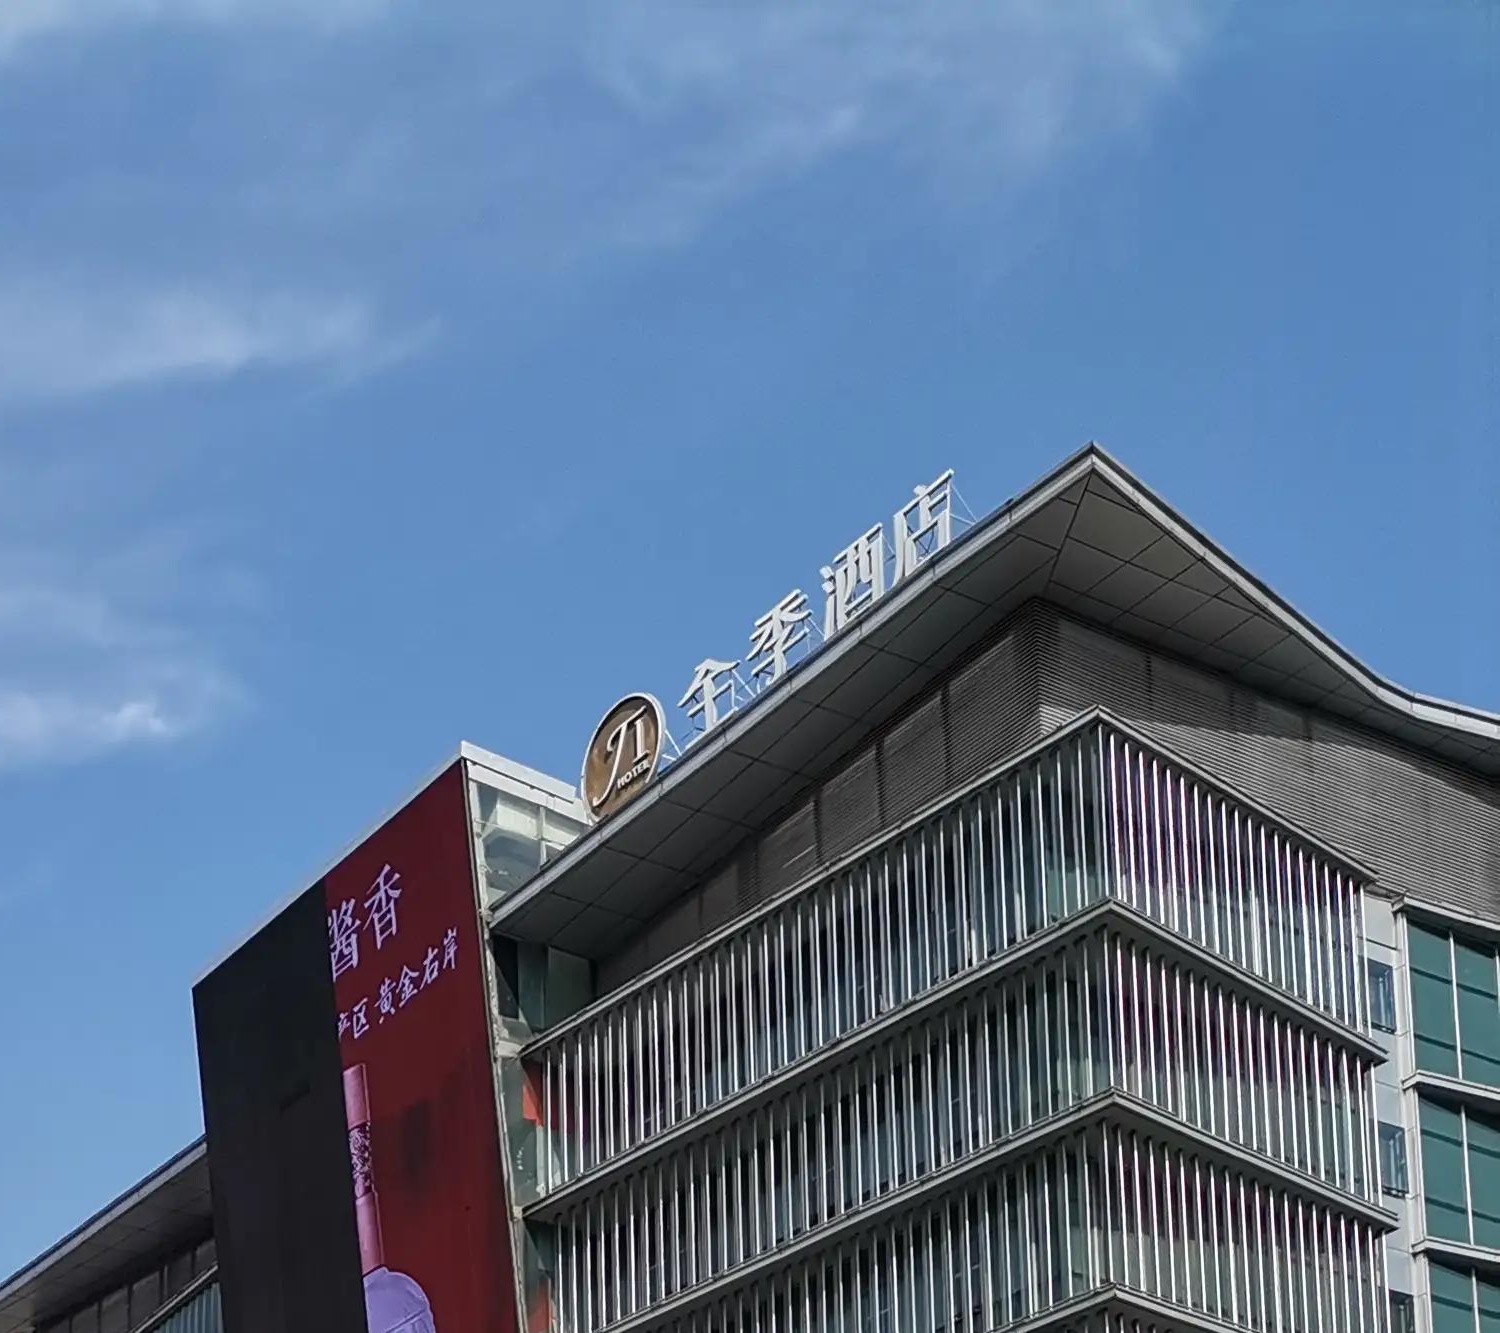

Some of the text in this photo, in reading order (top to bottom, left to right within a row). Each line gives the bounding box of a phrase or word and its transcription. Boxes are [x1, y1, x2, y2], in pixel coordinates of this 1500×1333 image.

[677, 468, 955, 730] 全季酒店
[616, 759, 651, 789] HOTEL
